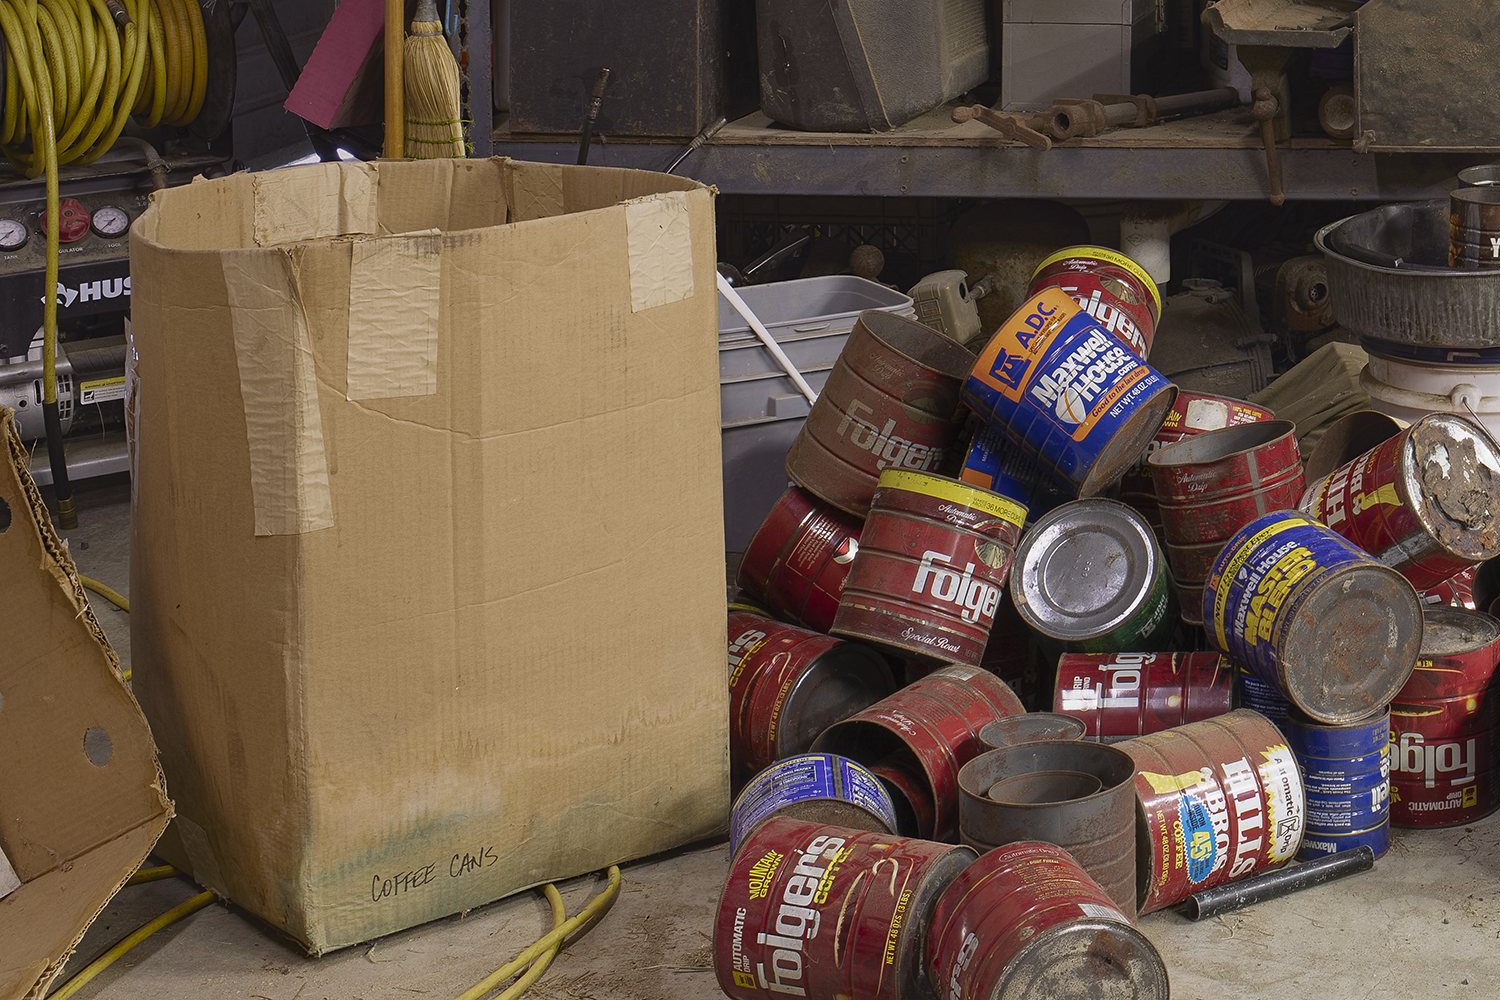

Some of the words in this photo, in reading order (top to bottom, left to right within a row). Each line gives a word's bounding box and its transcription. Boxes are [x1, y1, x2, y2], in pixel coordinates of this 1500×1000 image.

[1015, 301, 1058, 349] A.D.C.
[1031, 329, 1114, 408] Maxwell
[1069, 347, 1133, 402] House
[1118, 361, 1139, 377] COFFEE
[1092, 399, 1110, 418] Good
[1109, 391, 1118, 401] to
[1114, 382, 1126, 396] the
[1124, 375, 1136, 388] last
[1134, 367, 1146, 380] drop
[1110, 406, 1122, 418] NET
[1132, 388, 1142, 399] 48
[1177, 470, 1217, 484] Automatic
[1187, 481, 1209, 493] Drip
[938, 503, 977, 521] Automatic
[946, 514, 965, 526] Drip
[994, 505, 1010, 517] MORE
[912, 549, 1002, 624] Folge
[1234, 572, 1261, 639] Maxwell
[1245, 547, 1316, 646] MASTER
[1258, 559, 1317, 642] BLEND
[901, 626, 935, 646] Special
[933, 636, 961, 653] Roast
[1274, 758, 1294, 817] Atomatic
[1408, 801, 1462, 811] AUTOMATIC
[1447, 791, 1462, 800] DRIP
[1156, 810, 1165, 822] NET
[1204, 791, 1230, 872] BROS
[1221, 756, 1265, 877] HILLS
[1173, 820, 1183, 869] COFFEE
[372, 862, 437, 902] COFFEE
[450, 846, 498, 878] CANS
[749, 849, 779, 900] MOUNTAIN
[760, 853, 784, 898] GROWN
[814, 844, 857, 904] COFFEE
[733, 907, 747, 971] AUTOMATIC
[890, 928, 899, 938] 48
[892, 915, 902, 928] OZS.
[743, 955, 751, 973] DRIP
[886, 953, 896, 965] NET
[888, 939, 897, 953] WT.
